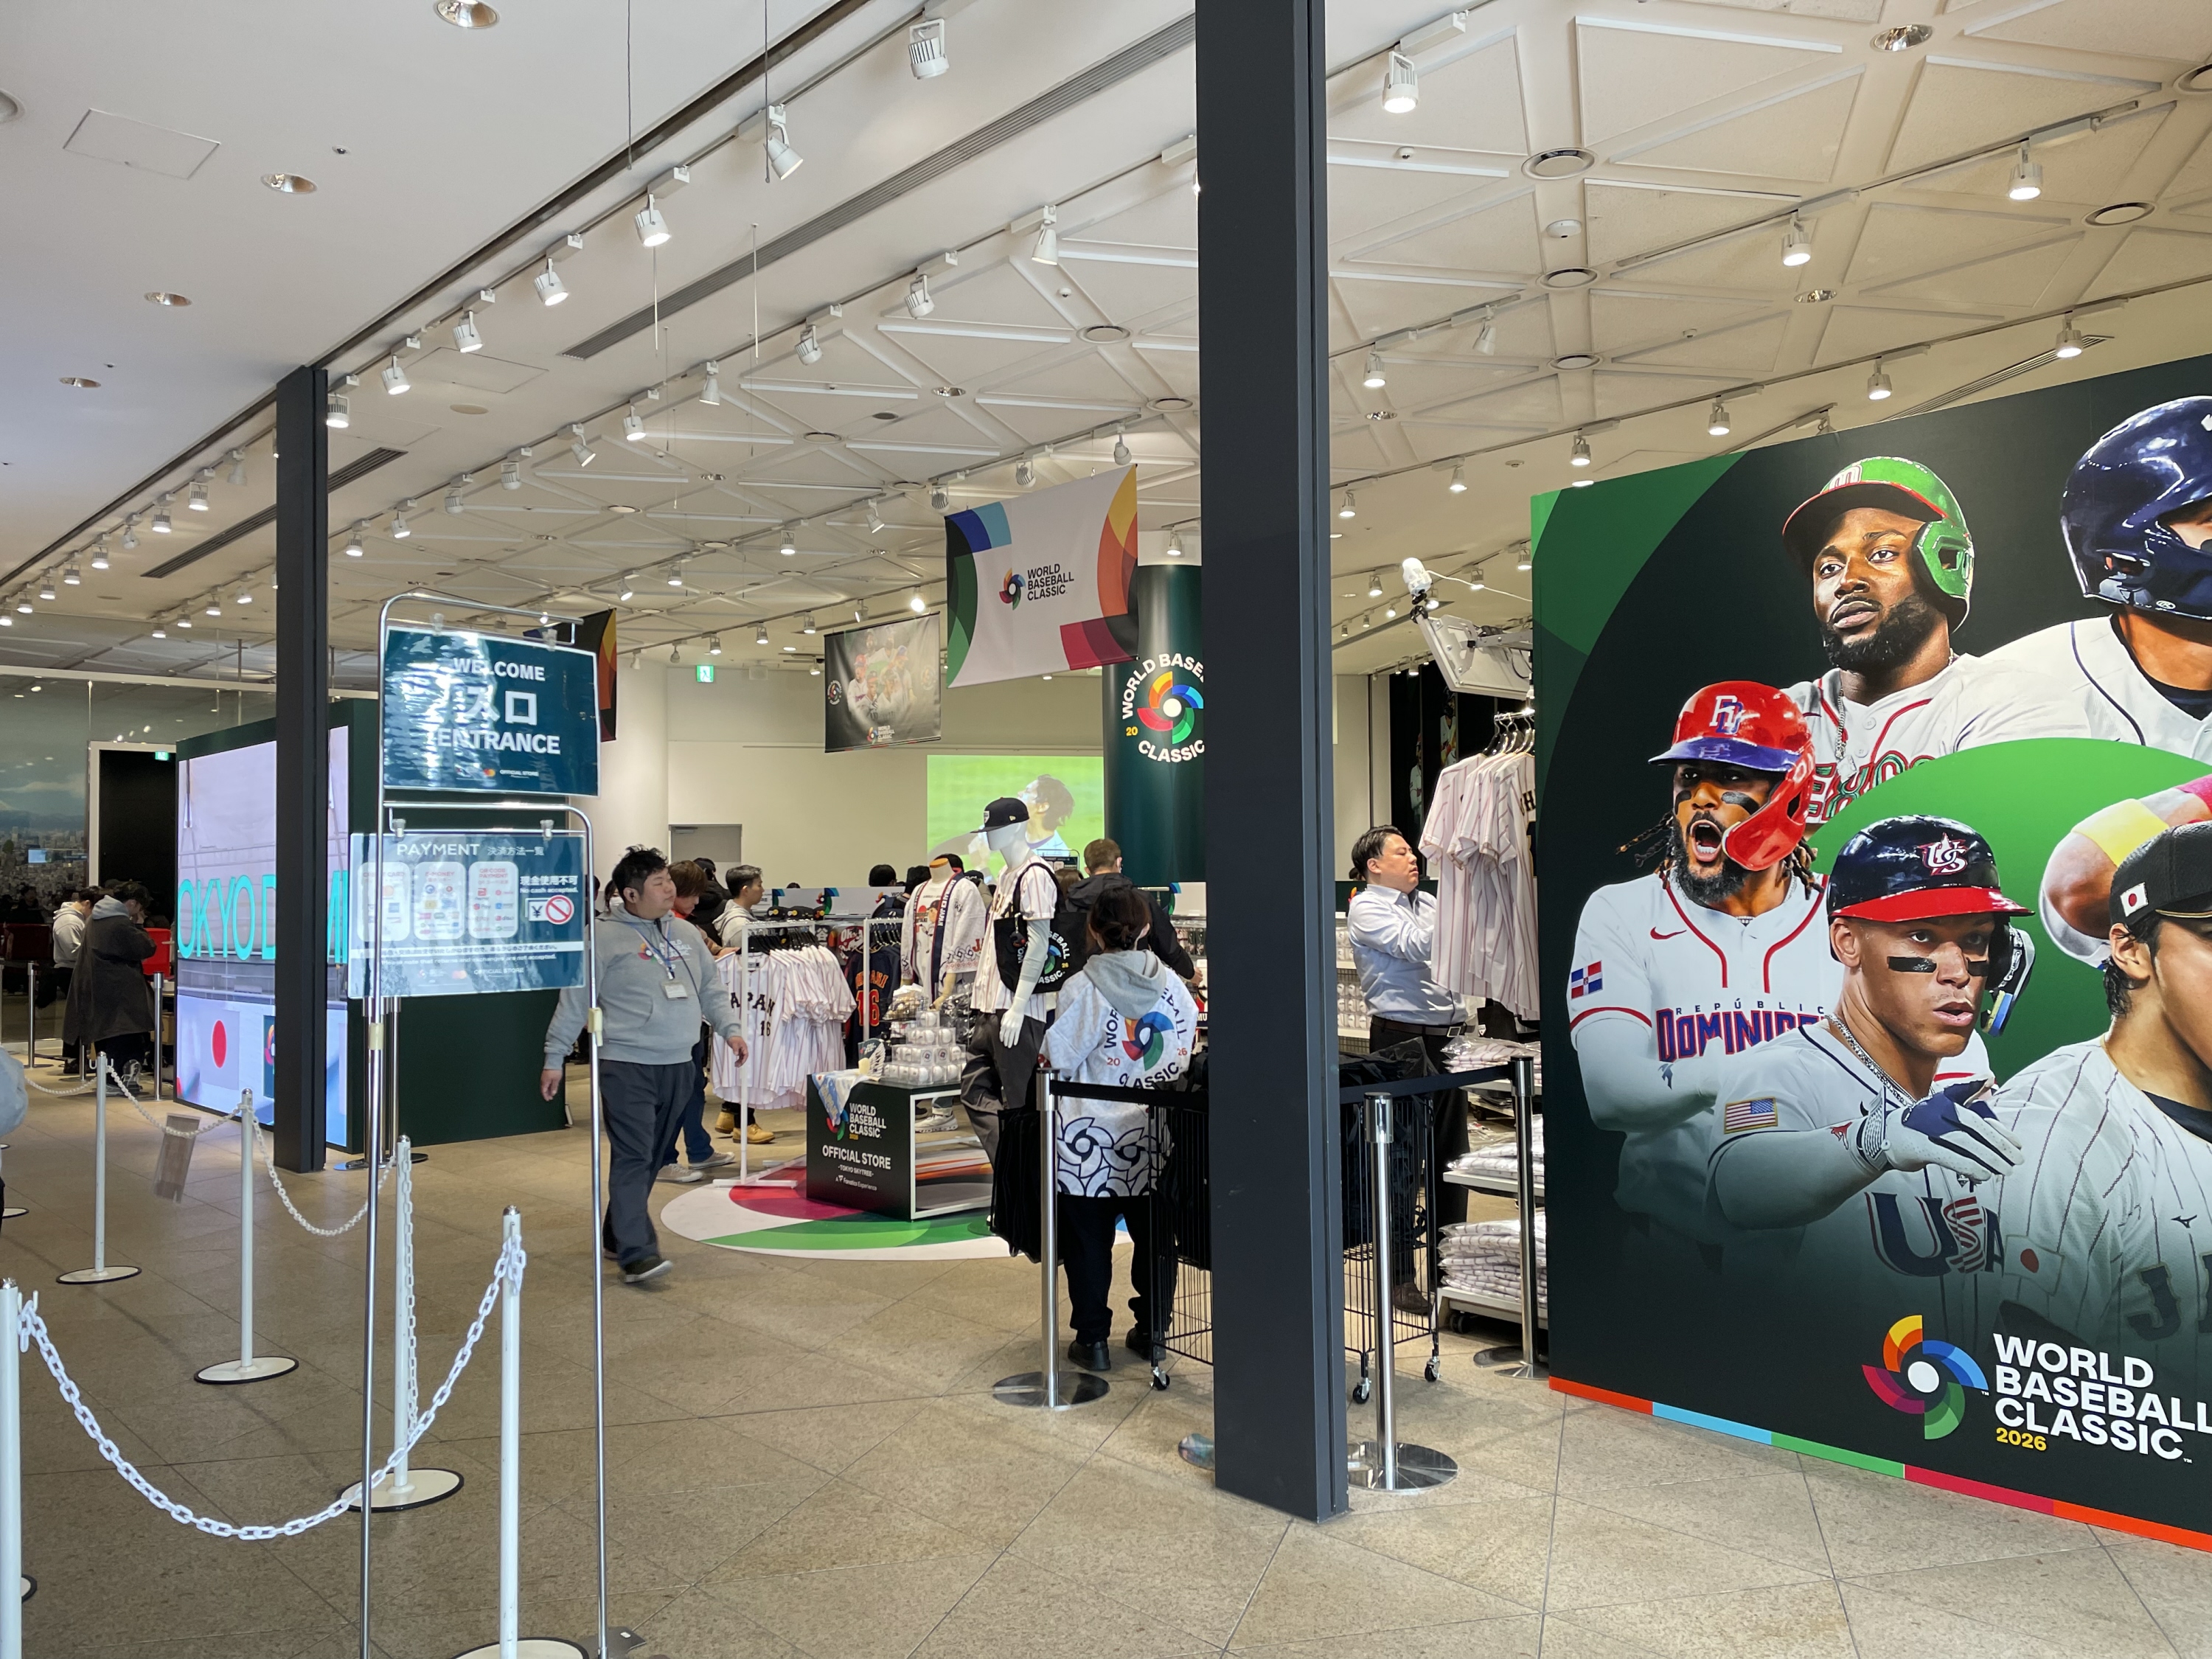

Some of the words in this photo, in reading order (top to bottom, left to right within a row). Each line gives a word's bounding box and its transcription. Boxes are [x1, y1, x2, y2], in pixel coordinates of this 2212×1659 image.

[1027, 563, 1060, 580] WORLD
[1028, 571, 1074, 591] BASEBALL
[1027, 584, 1066, 601] CLASSIC
[453, 657, 546, 682] WELCOME
[1122, 658, 1156, 720] WORLD
[465, 686, 538, 726] 入口
[437, 728, 561, 755] ENTRANCE
[1126, 726, 1138, 737] 20
[1138, 740, 1206, 763] CLASSIC
[397, 844, 480, 856] PAYMENT
[487, 846, 545, 856] 決済方法一覧
[520, 875, 578, 886] 現金使用不可
[178, 874, 256, 961] OKYO
[1048, 931, 1071, 959] SEBALL
[1038, 970, 1063, 984] ASSIC
[730, 992, 776, 1017] APAN
[855, 988, 880, 1028] 16
[1161, 987, 1187, 1040] EBALL
[1676, 998, 1825, 1015] REPÚBLIC
[760, 1020, 771, 1037] 16
[1104, 1009, 1119, 1048] WOR
[1656, 1007, 1825, 1063] DOMINIC
[1107, 1057, 1120, 1066] 20
[849, 1102, 876, 1116] WORLD
[849, 1114, 887, 1130] BASEBALL
[849, 1124, 881, 1139] CLASSIC
[822, 1144, 861, 1164] OFFICIAL
[861, 1152, 891, 1170] STORE
[1992, 1332, 2154, 1388] WORLD
[1995, 1364, 2212, 1435] BASEBALL
[1994, 1397, 2184, 1460] CLASSIC
[1995, 1427, 2048, 1452] 2026
